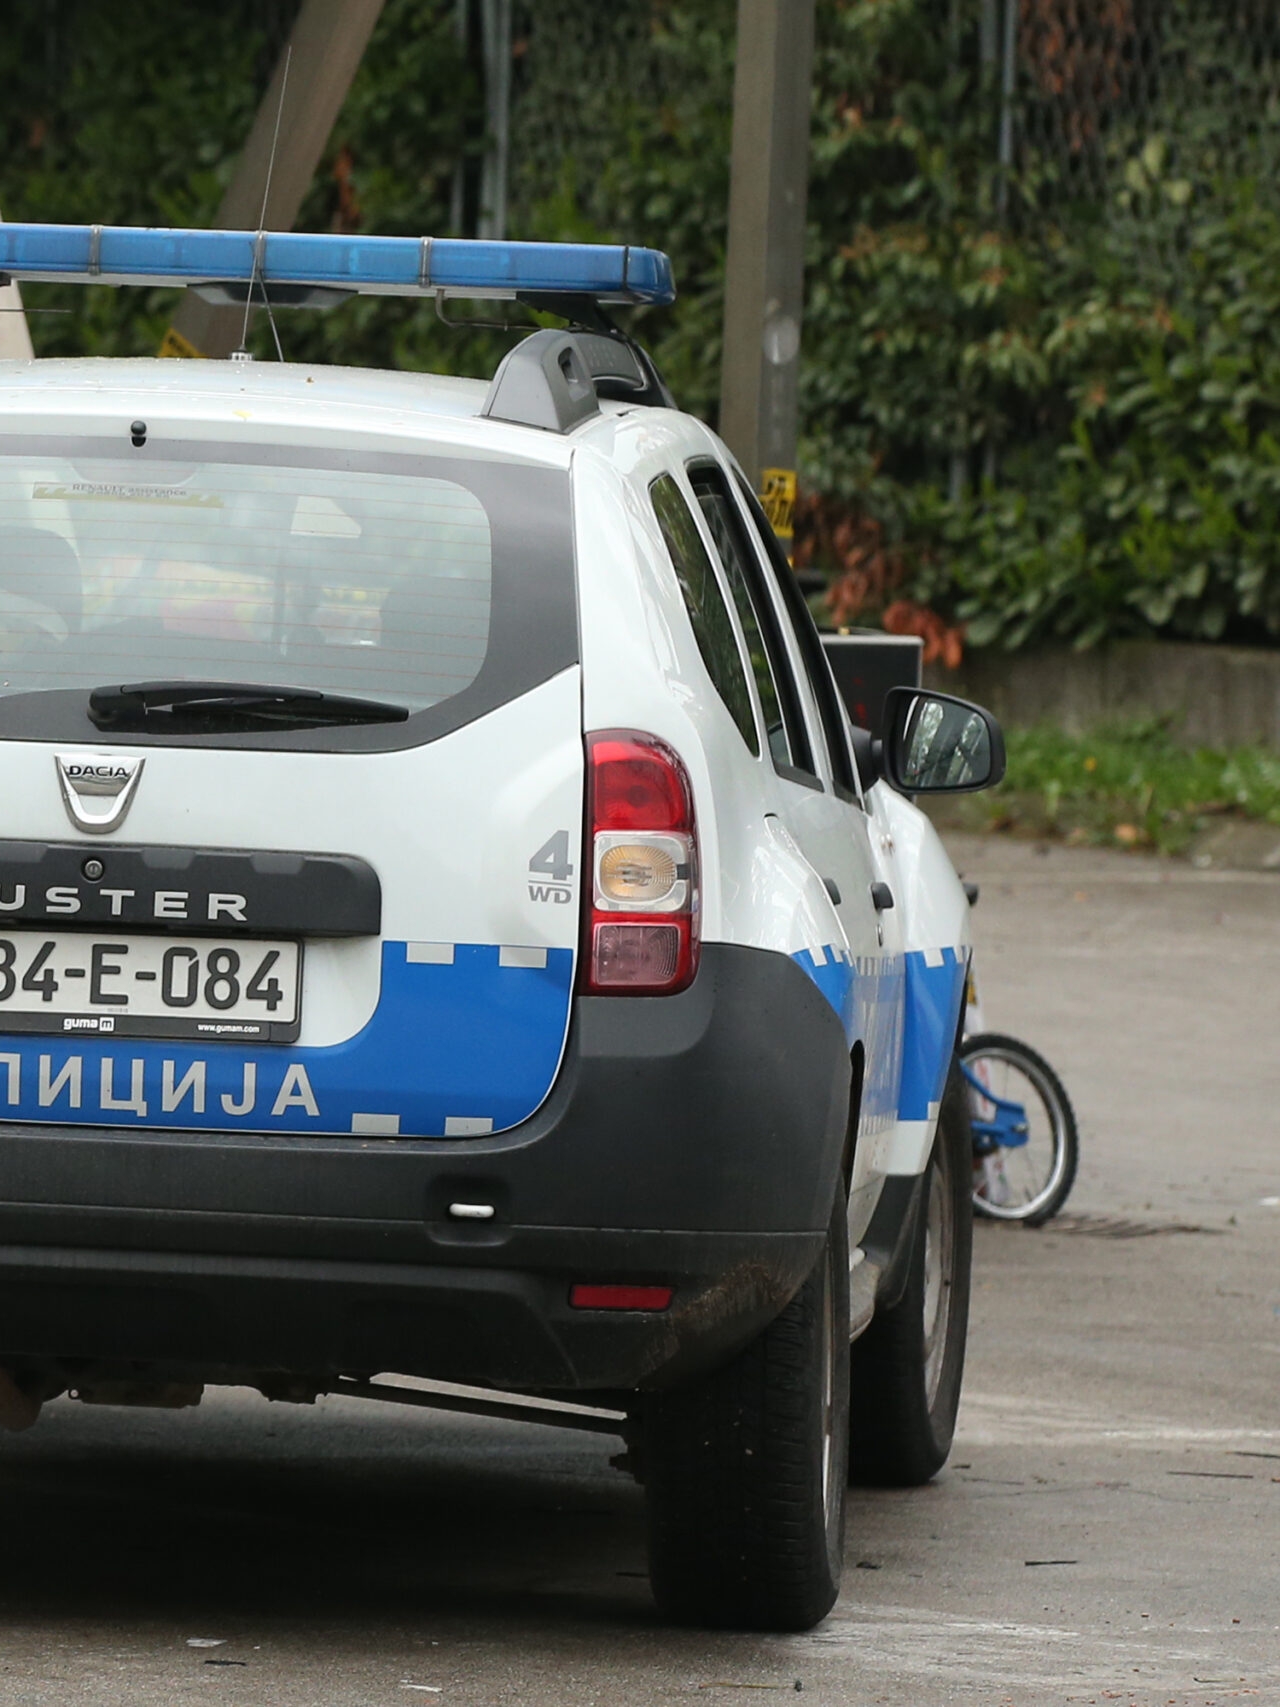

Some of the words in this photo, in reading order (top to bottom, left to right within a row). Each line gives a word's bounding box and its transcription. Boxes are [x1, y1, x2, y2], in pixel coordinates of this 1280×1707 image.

[68, 766, 128, 778] DACIA
[529, 830, 573, 880] 4
[528, 886, 572, 904] WD
[198, 1024, 260, 1034] www.gumam.com
